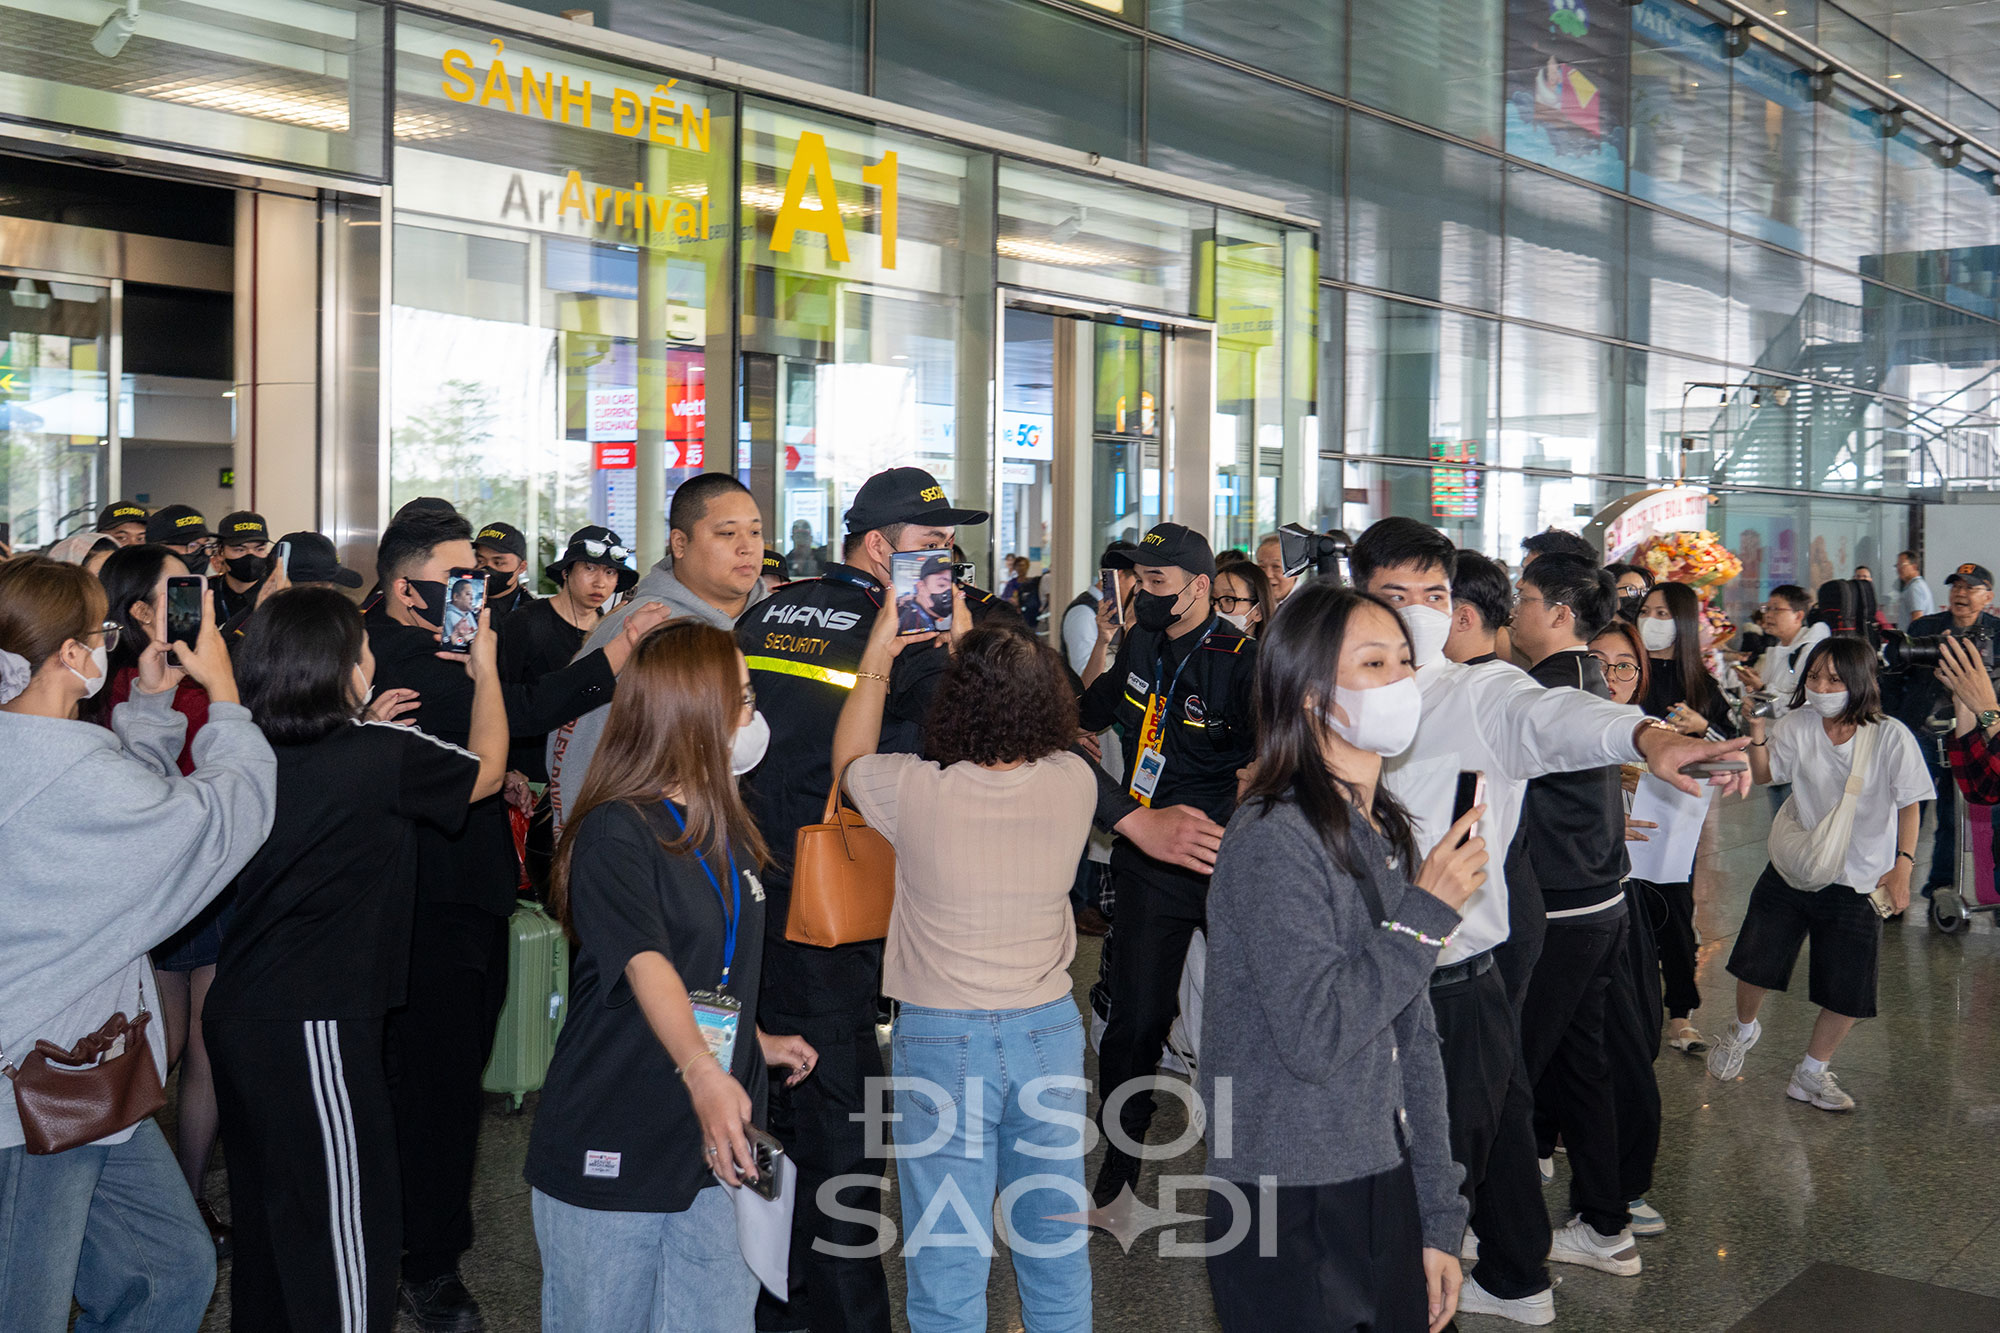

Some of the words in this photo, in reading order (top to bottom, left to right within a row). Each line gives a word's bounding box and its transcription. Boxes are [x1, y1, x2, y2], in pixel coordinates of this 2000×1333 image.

[442, 38, 592, 128] SẢNH
[610, 78, 711, 153] ĐẾN
[557, 169, 710, 240] Arrival
[769, 130, 898, 270] A1
[233, 522, 263, 531] SECURITY
[764, 632, 831, 656] SECURITY
